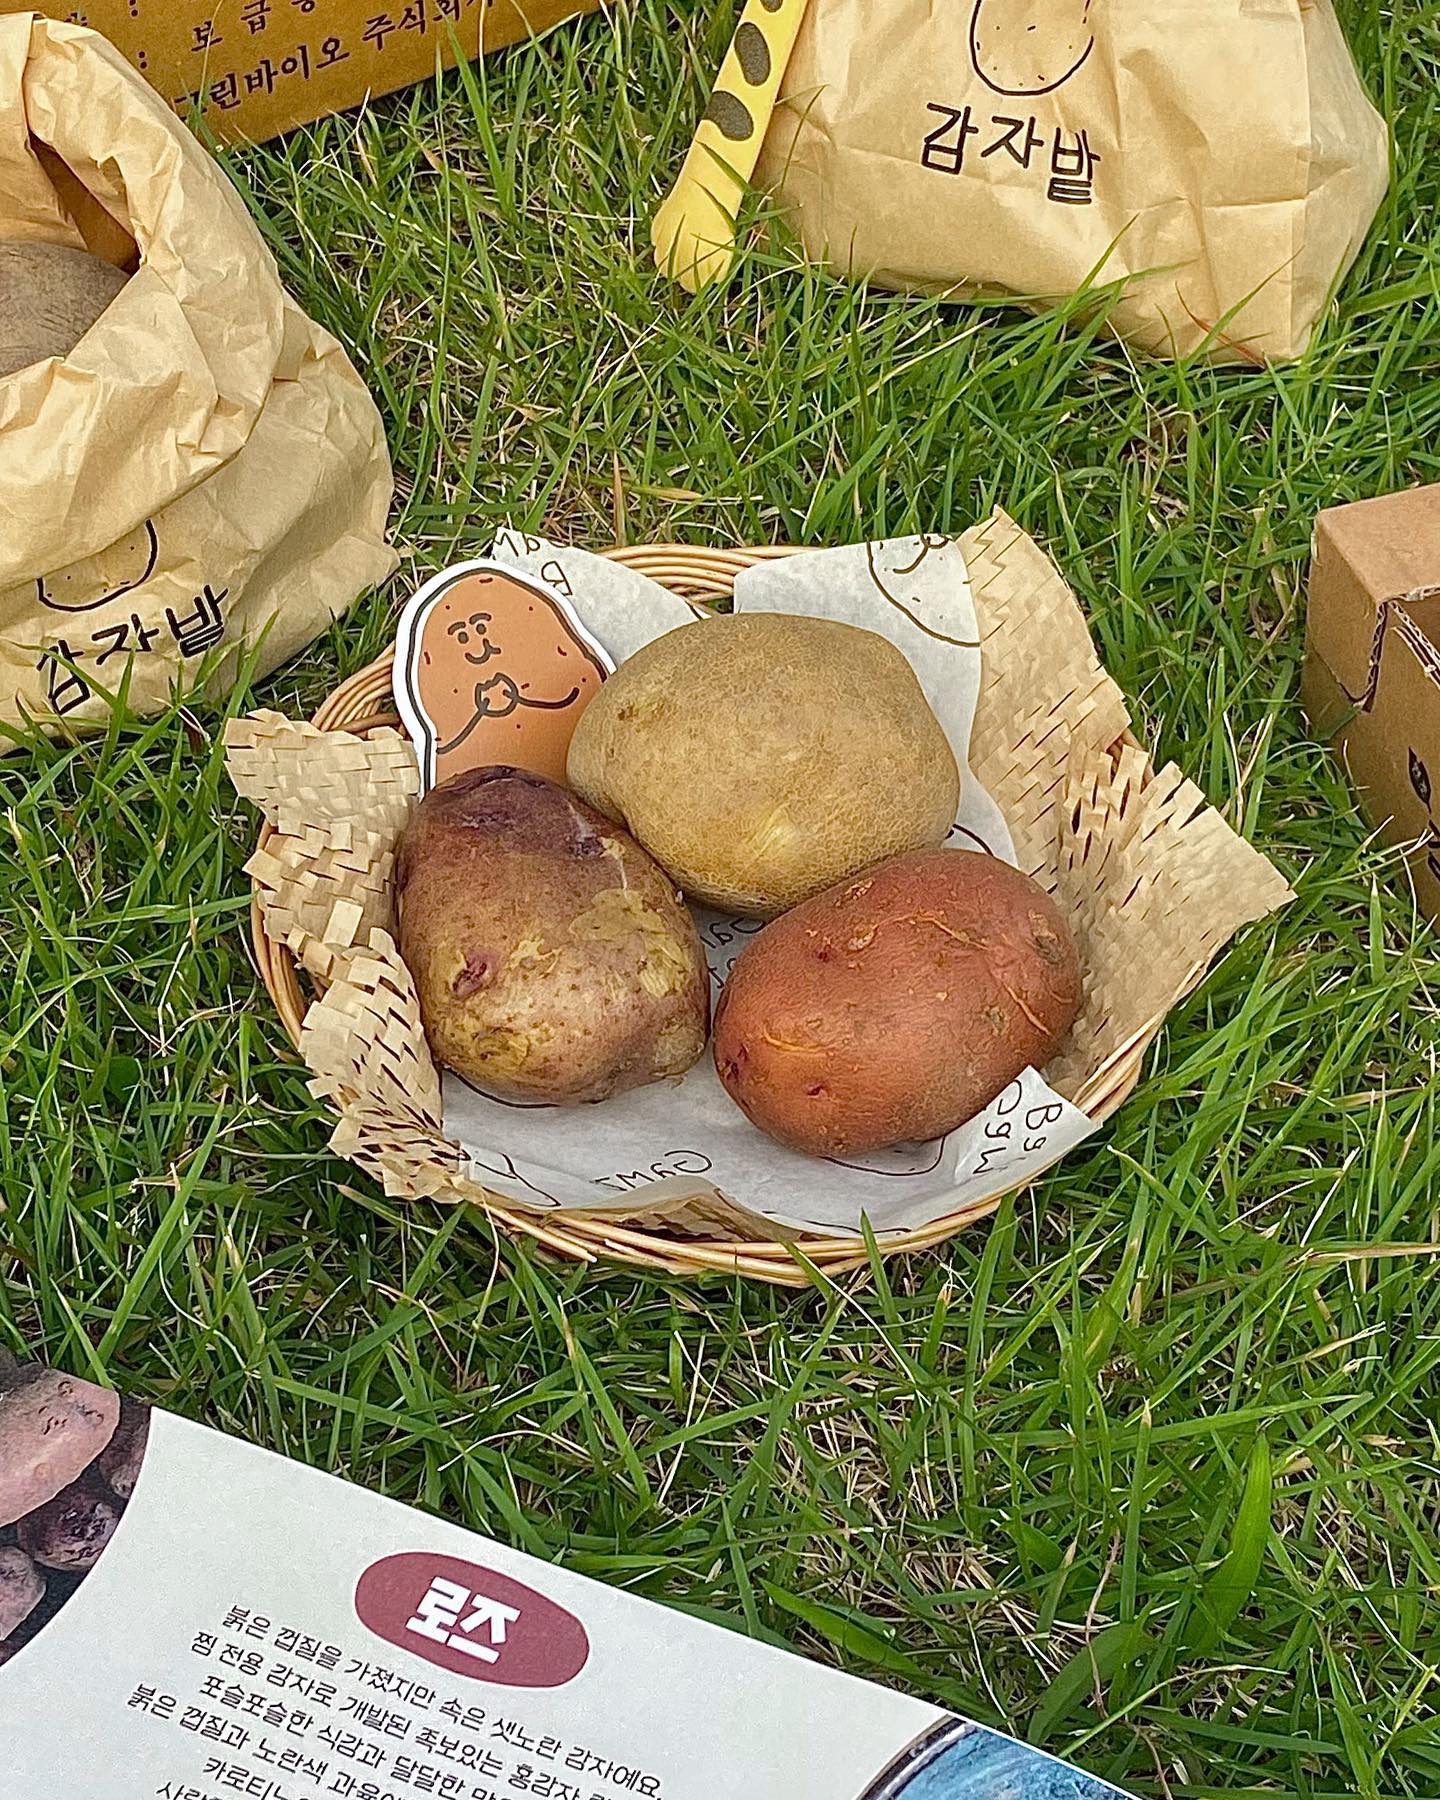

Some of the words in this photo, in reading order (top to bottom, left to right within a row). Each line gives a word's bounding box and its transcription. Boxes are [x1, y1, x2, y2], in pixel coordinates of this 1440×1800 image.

[362, 0, 493, 51] 주식회
[921, 102, 1101, 205] 감자밭
[36, 584, 229, 716] 감자밭
[222, 1605, 271, 1640] 붉은
[274, 1627, 342, 1671] 껍질을
[344, 1659, 436, 1710] 가졌지만
[439, 1698, 486, 1731] 속은
[405, 1576, 521, 1664] 로즈
[127, 1684, 177, 1720] 붉은
[179, 1706, 251, 1750] 껍질과
[252, 1738, 329, 1785] 노란색
[191, 1631, 218, 1657] 찜
[219, 1643, 264, 1676] 전용
[266, 1663, 337, 1708] 감자로
[338, 1697, 412, 1740] 개발된
[415, 1727, 503, 1778] 족보있는
[508, 1763, 580, 1800] 홍감자
[199, 1675, 314, 1737] 포슬포슬한
[317, 1725, 387, 1769] 식감과
[390, 1755, 466, 1800] 달달한
